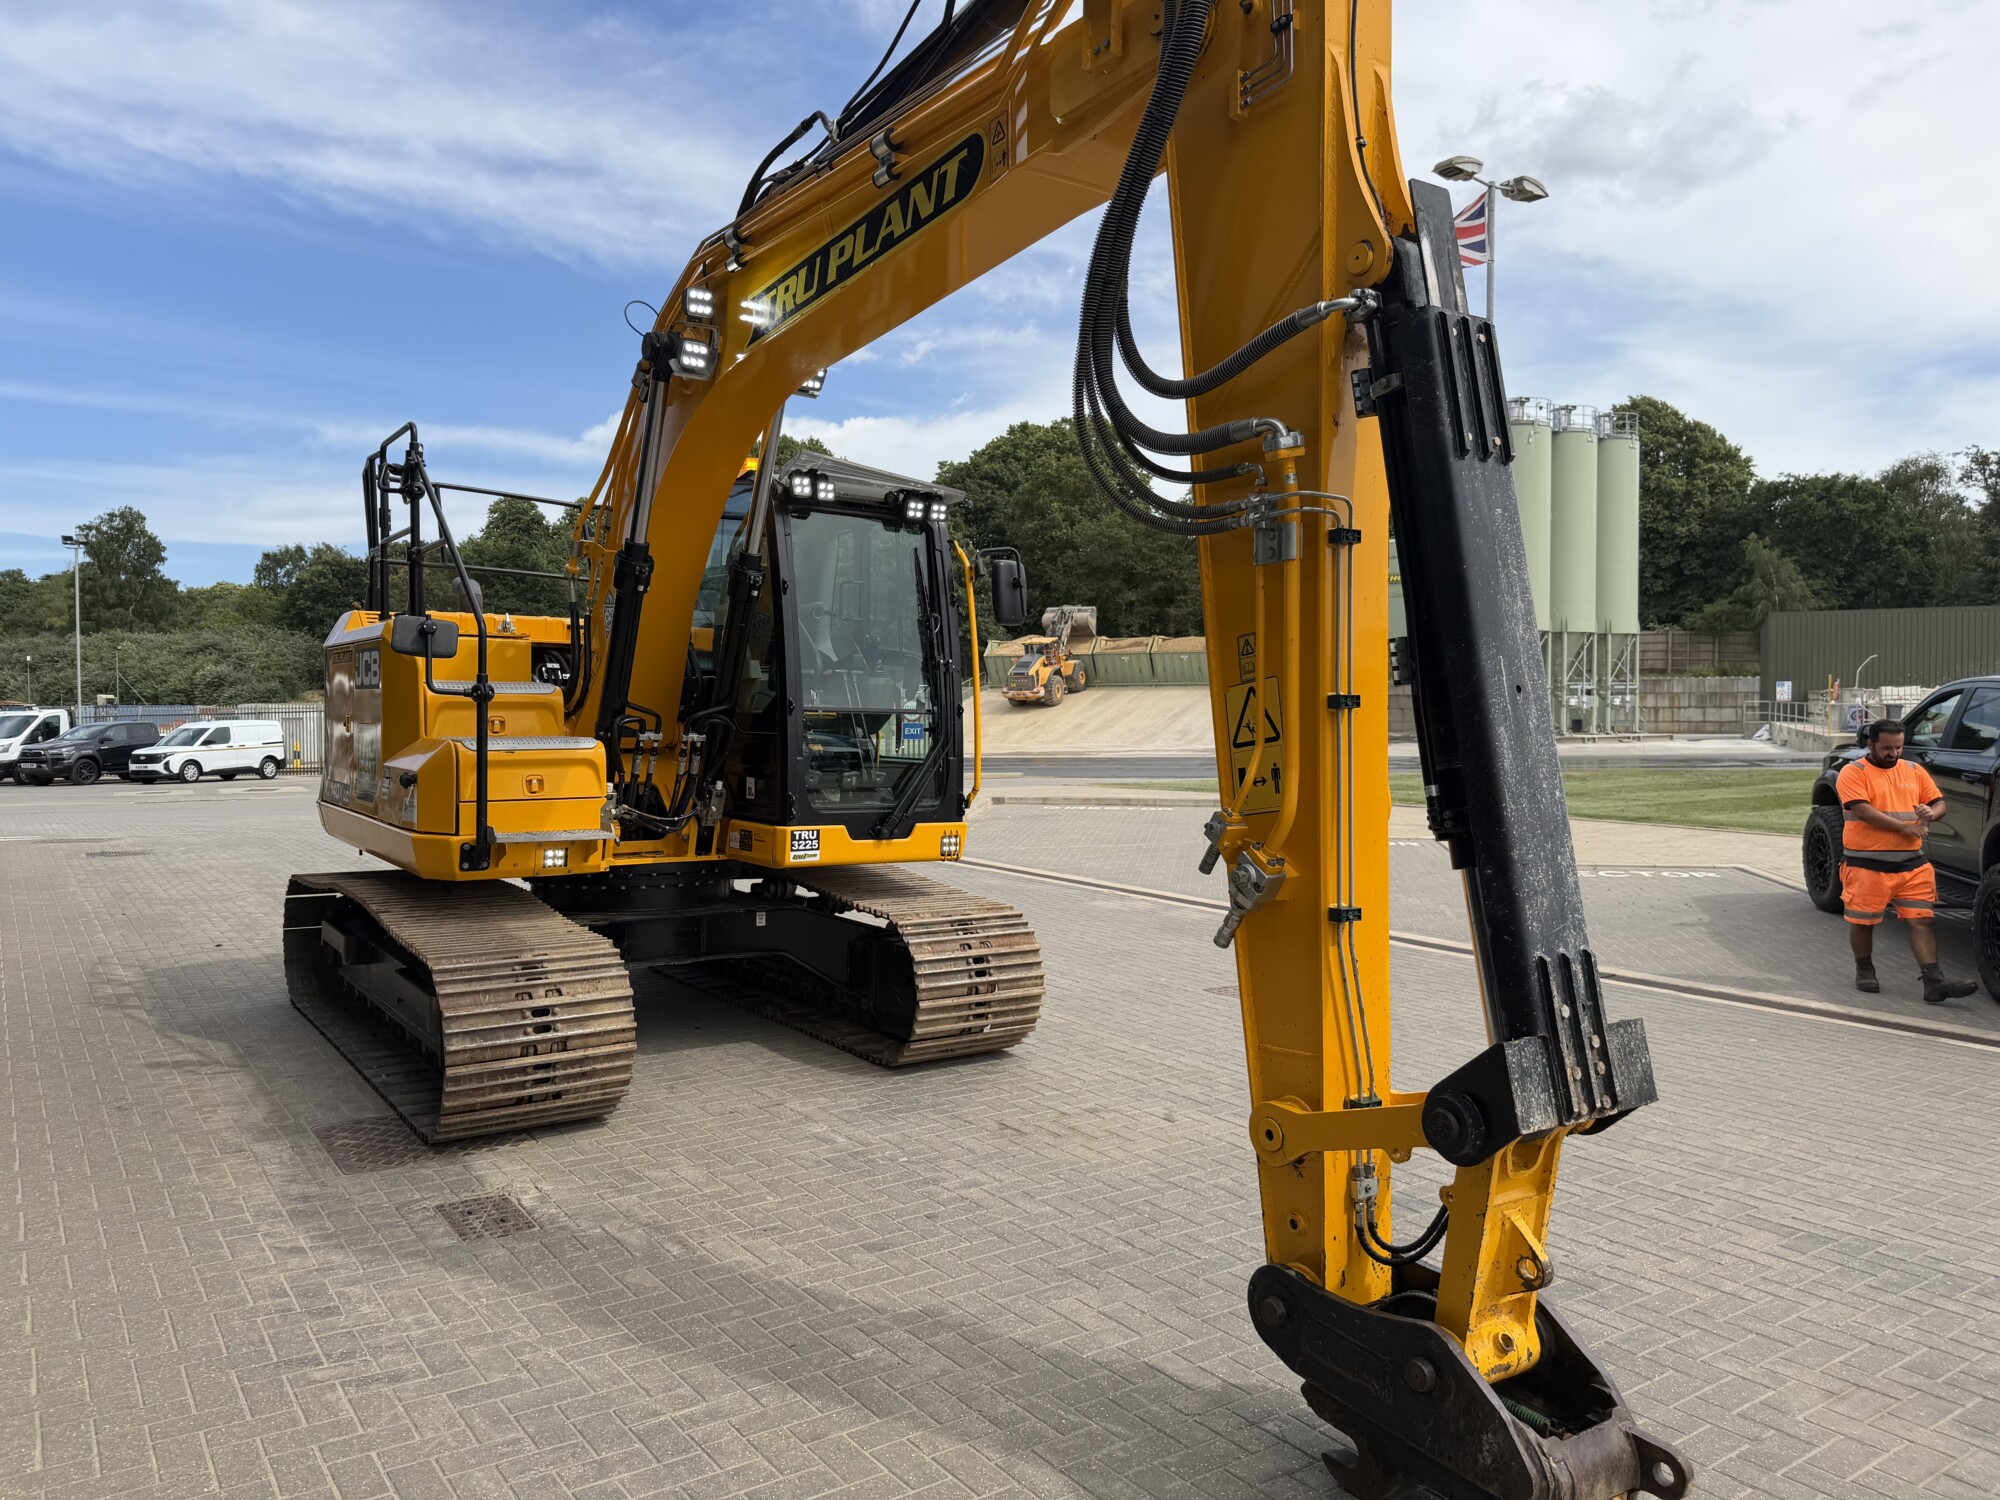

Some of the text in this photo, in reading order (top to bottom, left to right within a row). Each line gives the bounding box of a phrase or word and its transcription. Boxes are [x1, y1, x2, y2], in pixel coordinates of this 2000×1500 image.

[753, 147, 968, 330] TRU PLANT
[355, 650, 380, 686] JCB
[904, 727, 922, 735] EXIT
[793, 830, 817, 840] TRU
[791, 840, 819, 850] 3225
[1577, 870, 1721, 878] ECTOR
